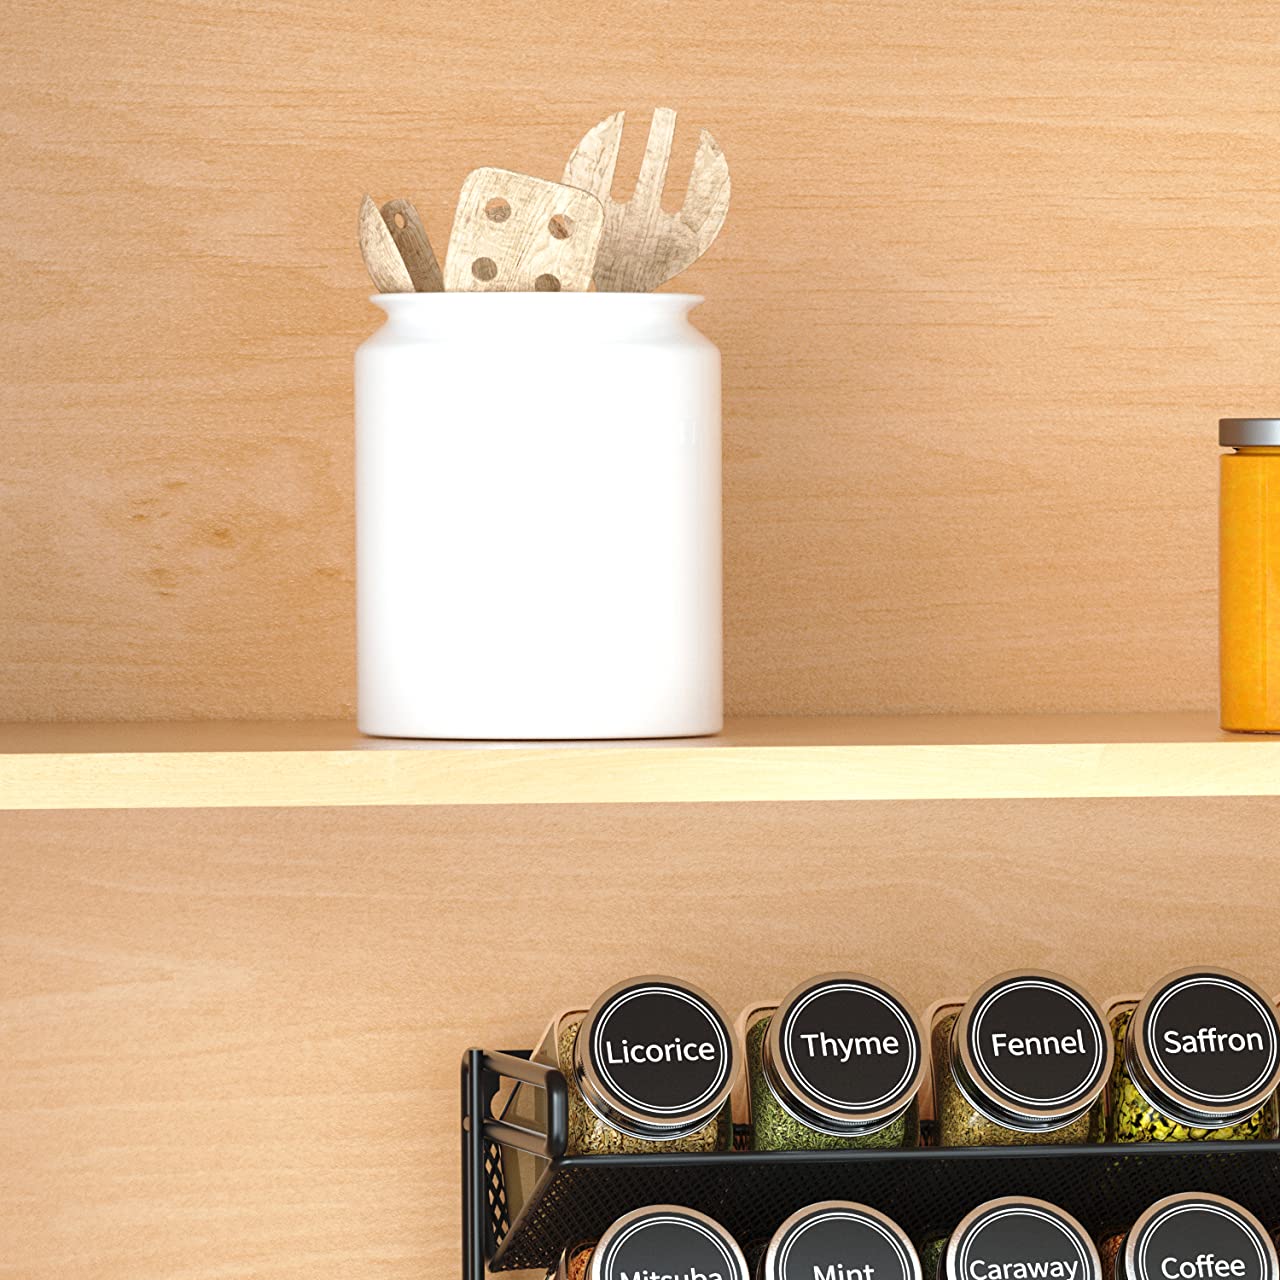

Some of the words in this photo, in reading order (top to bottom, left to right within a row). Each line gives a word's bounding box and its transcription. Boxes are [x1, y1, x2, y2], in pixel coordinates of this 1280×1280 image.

[606, 1037, 715, 1064] Licorice
[799, 1031, 899, 1063] Thyme
[991, 1028, 1086, 1057] Fennel
[1163, 1027, 1264, 1054] Saffron
[1161, 1253, 1246, 1280] Coffee
